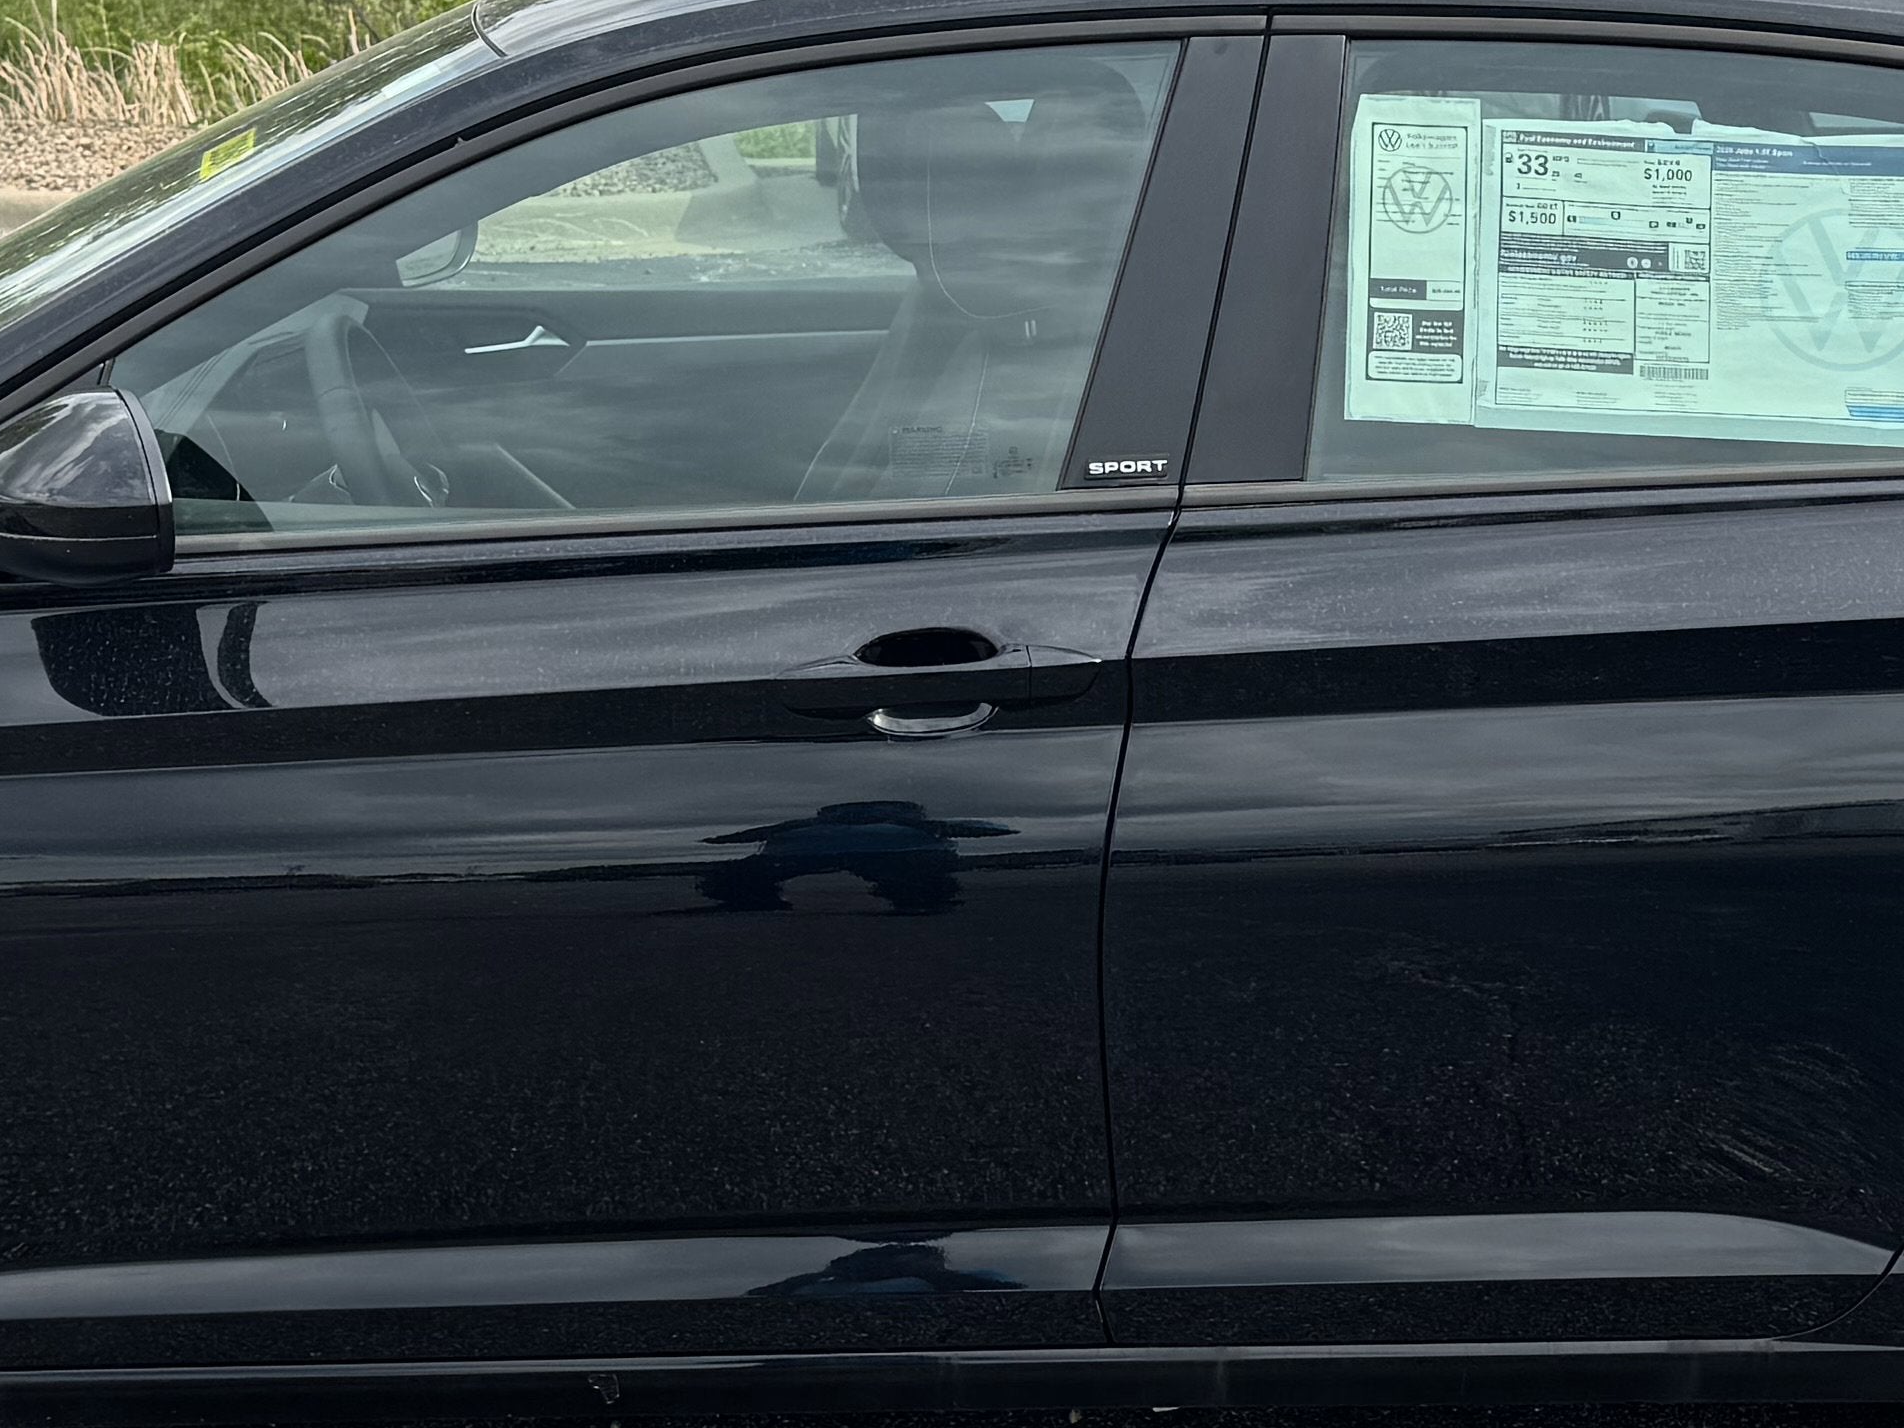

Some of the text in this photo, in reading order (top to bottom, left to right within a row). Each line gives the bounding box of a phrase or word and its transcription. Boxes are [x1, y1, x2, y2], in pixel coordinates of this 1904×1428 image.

[1517, 154, 1549, 176] 33
[1644, 168, 1692, 182] $1,000
[1508, 210, 1556, 224] $1,500
[1088, 459, 1168, 475] SPORT
